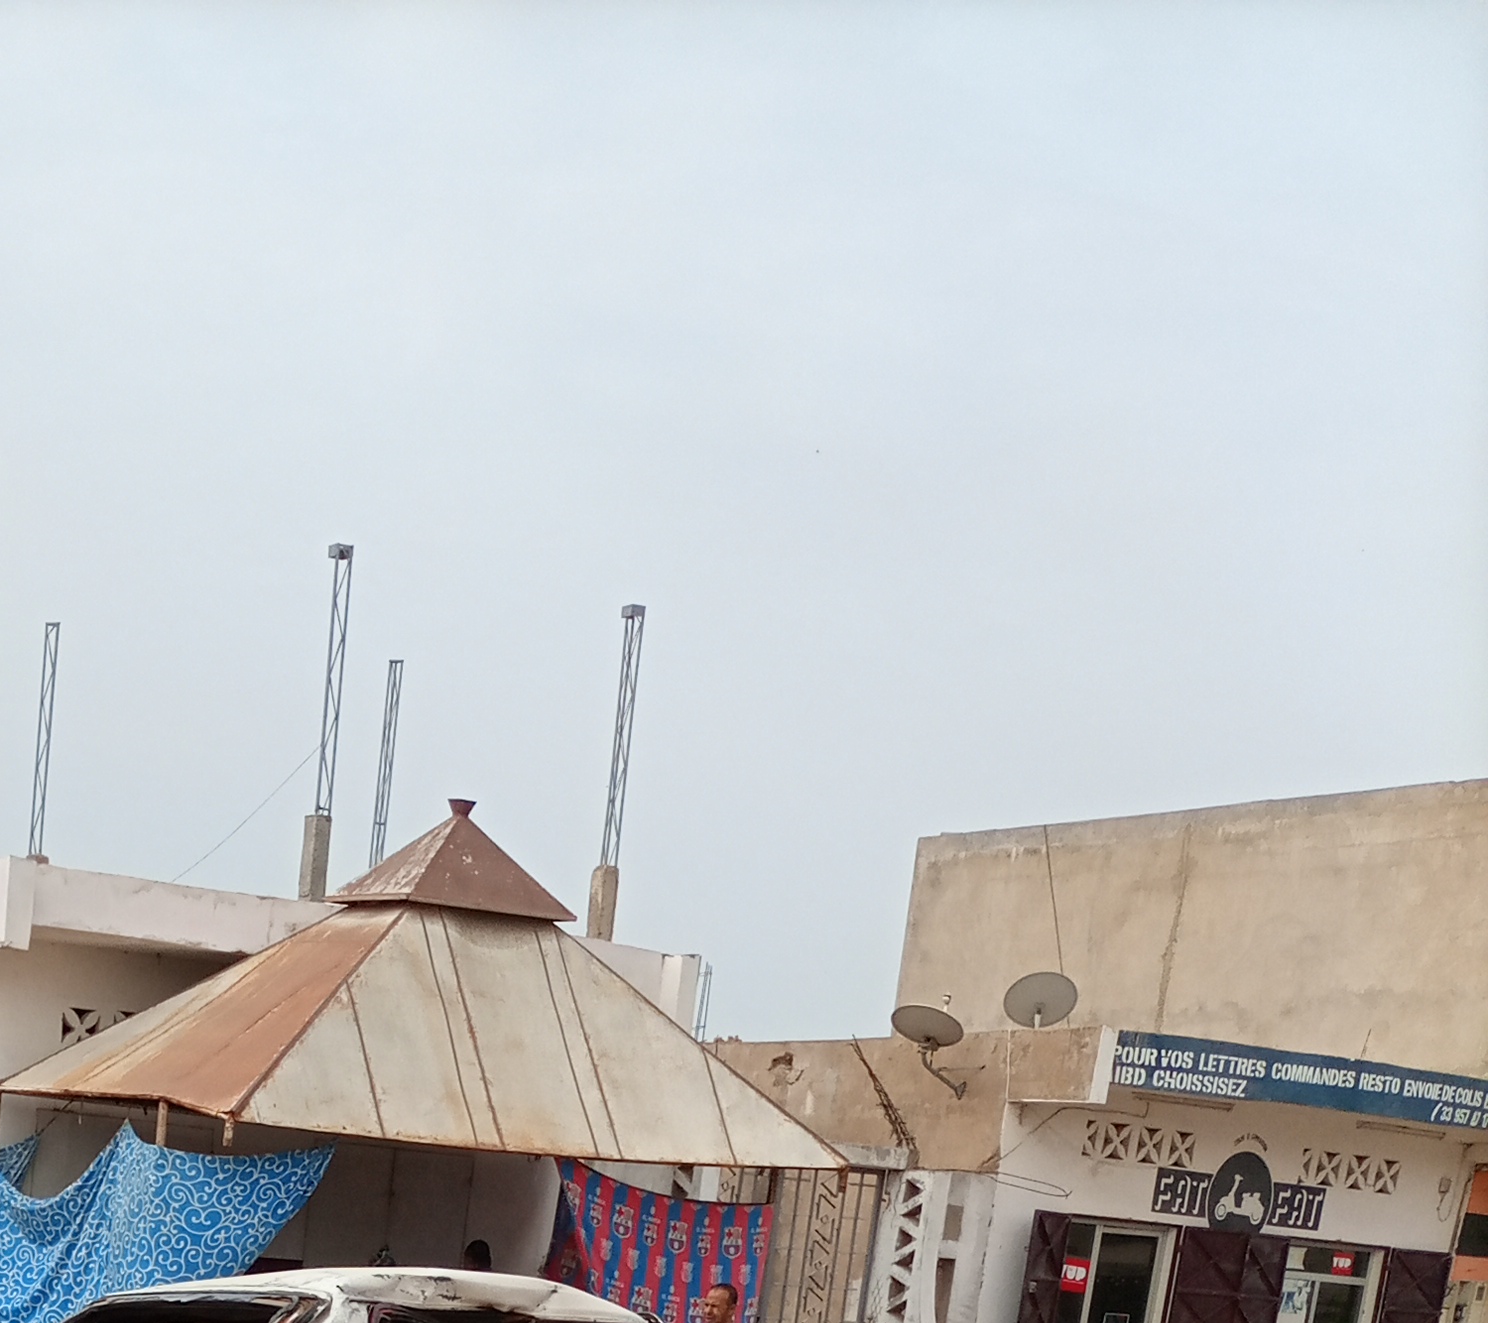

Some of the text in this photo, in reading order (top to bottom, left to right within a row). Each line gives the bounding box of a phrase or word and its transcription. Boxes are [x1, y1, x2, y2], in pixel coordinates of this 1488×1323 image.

[1113, 1045, 1158, 1068] POUR
[1161, 1049, 1194, 1070] VOS
[1198, 1052, 1267, 1078] LETTRES
[1271, 1062, 1356, 1088] COMMANDES
[1359, 1073, 1401, 1095] RESTO
[1403, 1079, 1443, 1101] ENVOIE
[1441, 1084, 1457, 1103] DE
[1455, 1087, 1484, 1107] COLIS
[1114, 1066, 1248, 1098] IBD CHOISSISEZ
[1154, 1174, 1323, 1228] FAT FAT
